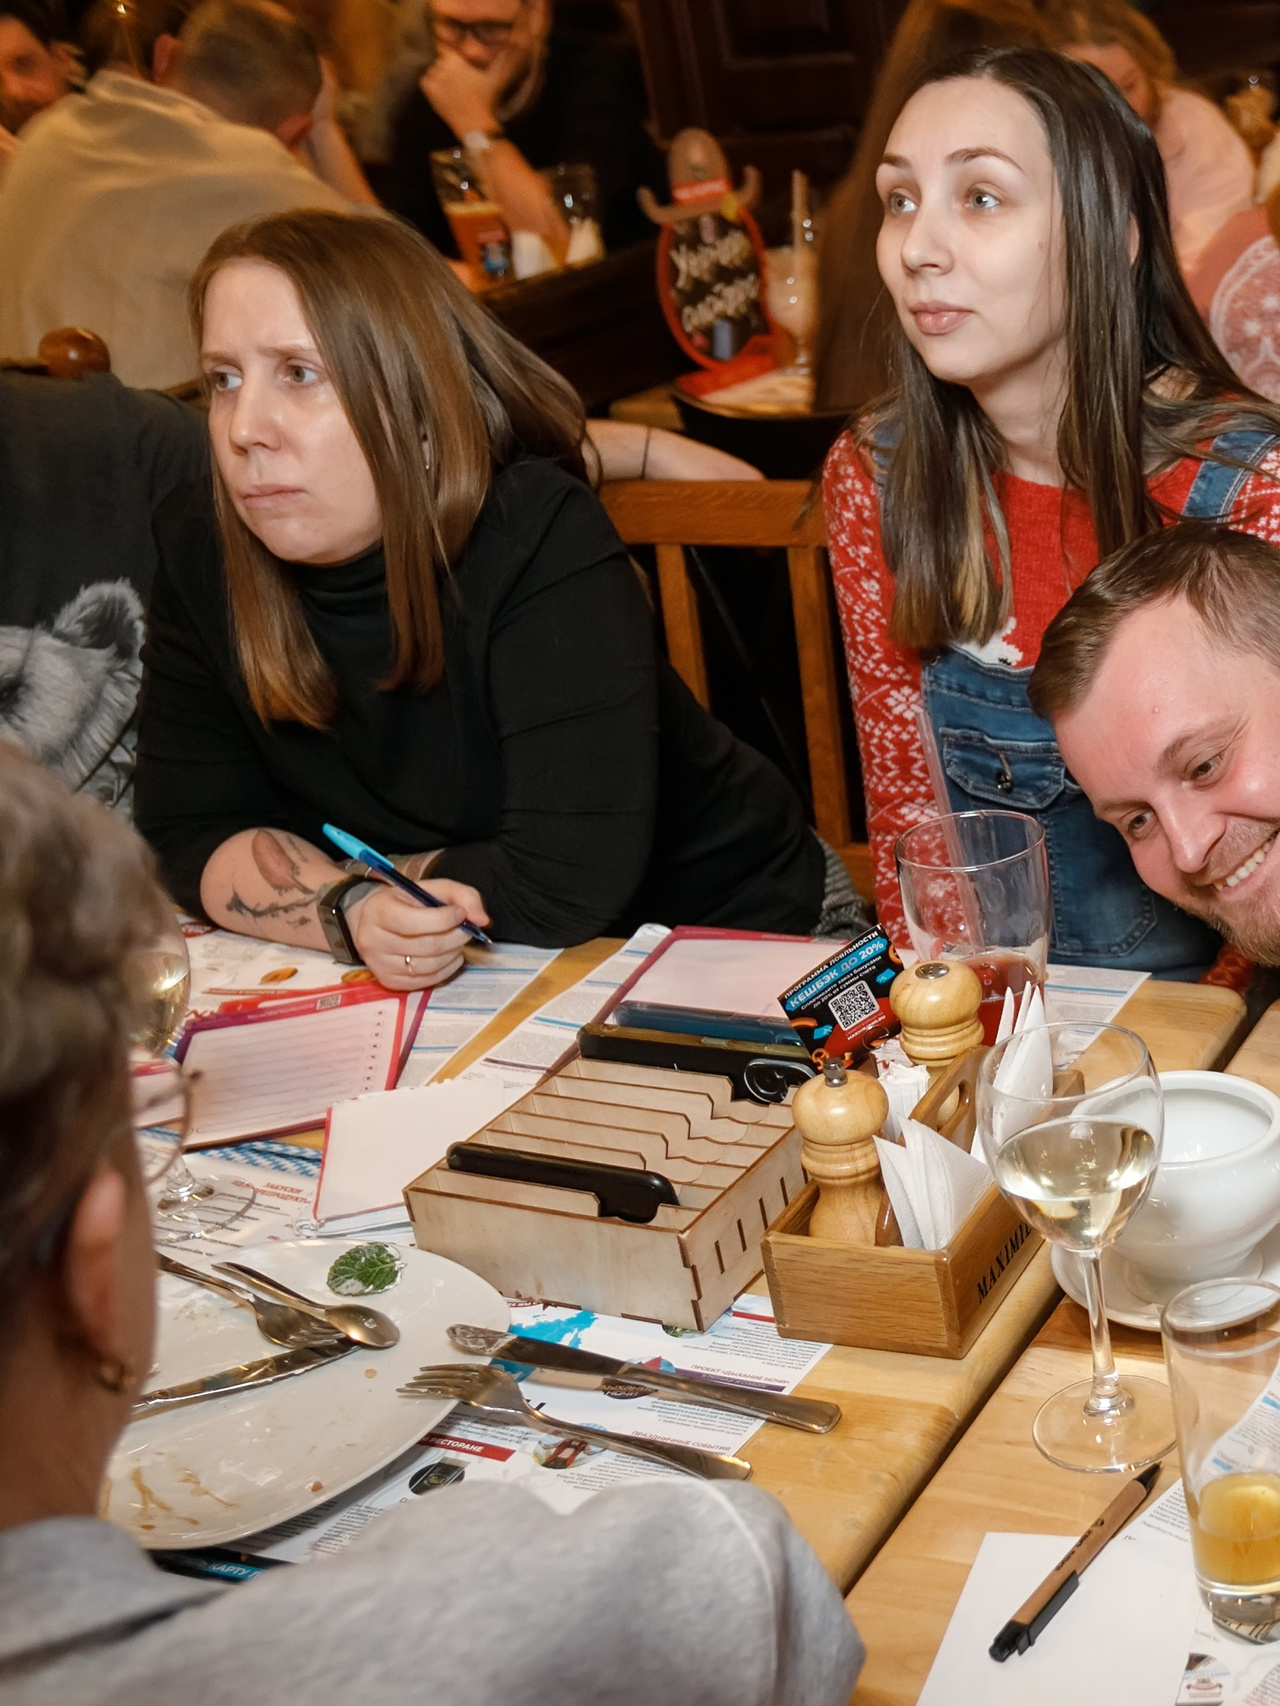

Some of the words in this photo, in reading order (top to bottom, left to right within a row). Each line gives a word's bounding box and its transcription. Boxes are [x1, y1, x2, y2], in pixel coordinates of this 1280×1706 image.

[784, 964, 829, 999] ПРОГРАММА
[829, 931, 878, 966] ЛОЯЛЬНОСТИ
[790, 968, 838, 1008] КЕШБЭК
[840, 956, 858, 973] ДО
[858, 941, 884, 960] 20%
[976, 1222, 1032, 1305] MAXIMIL
